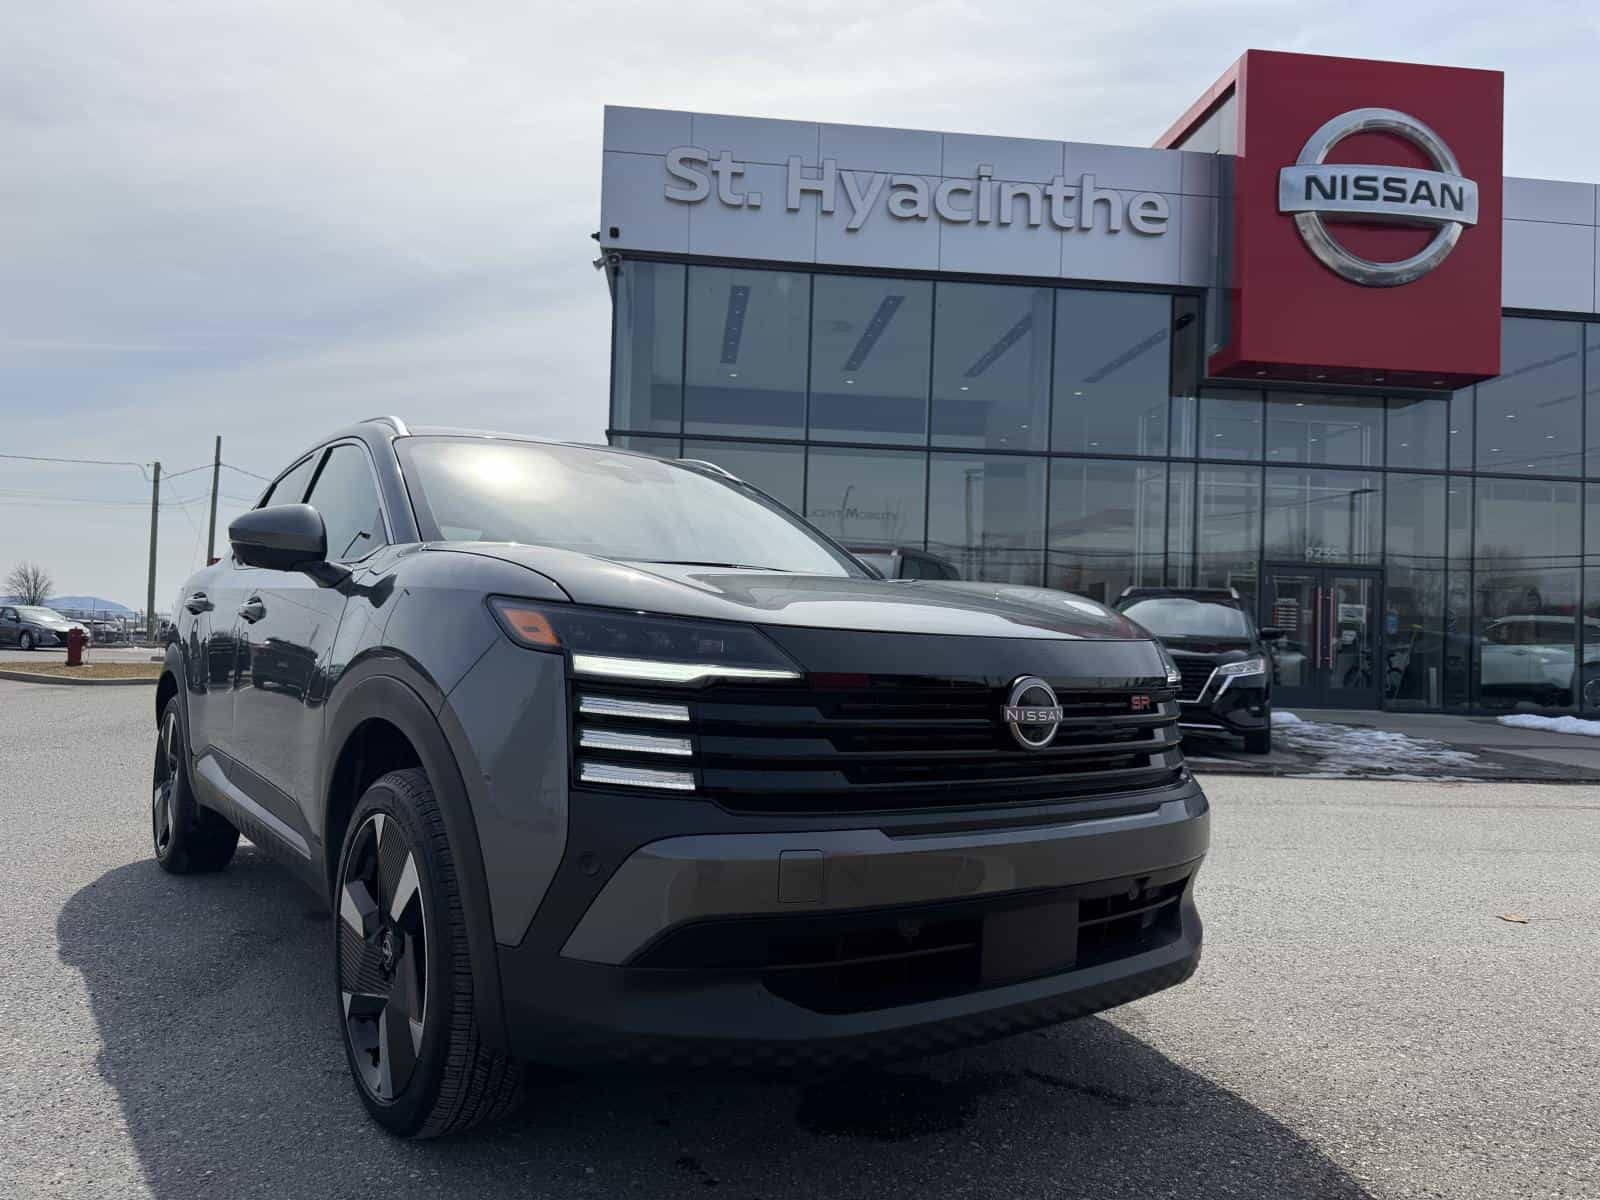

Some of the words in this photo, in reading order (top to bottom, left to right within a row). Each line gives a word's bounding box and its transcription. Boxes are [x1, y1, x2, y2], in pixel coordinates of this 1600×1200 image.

[664, 145, 761, 208] St.
[786, 155, 1170, 236] Hyacinthe
[1304, 174, 1465, 212] NISSAN
[1131, 695, 1151, 709] SR
[1007, 710, 1062, 721] NISSAN
